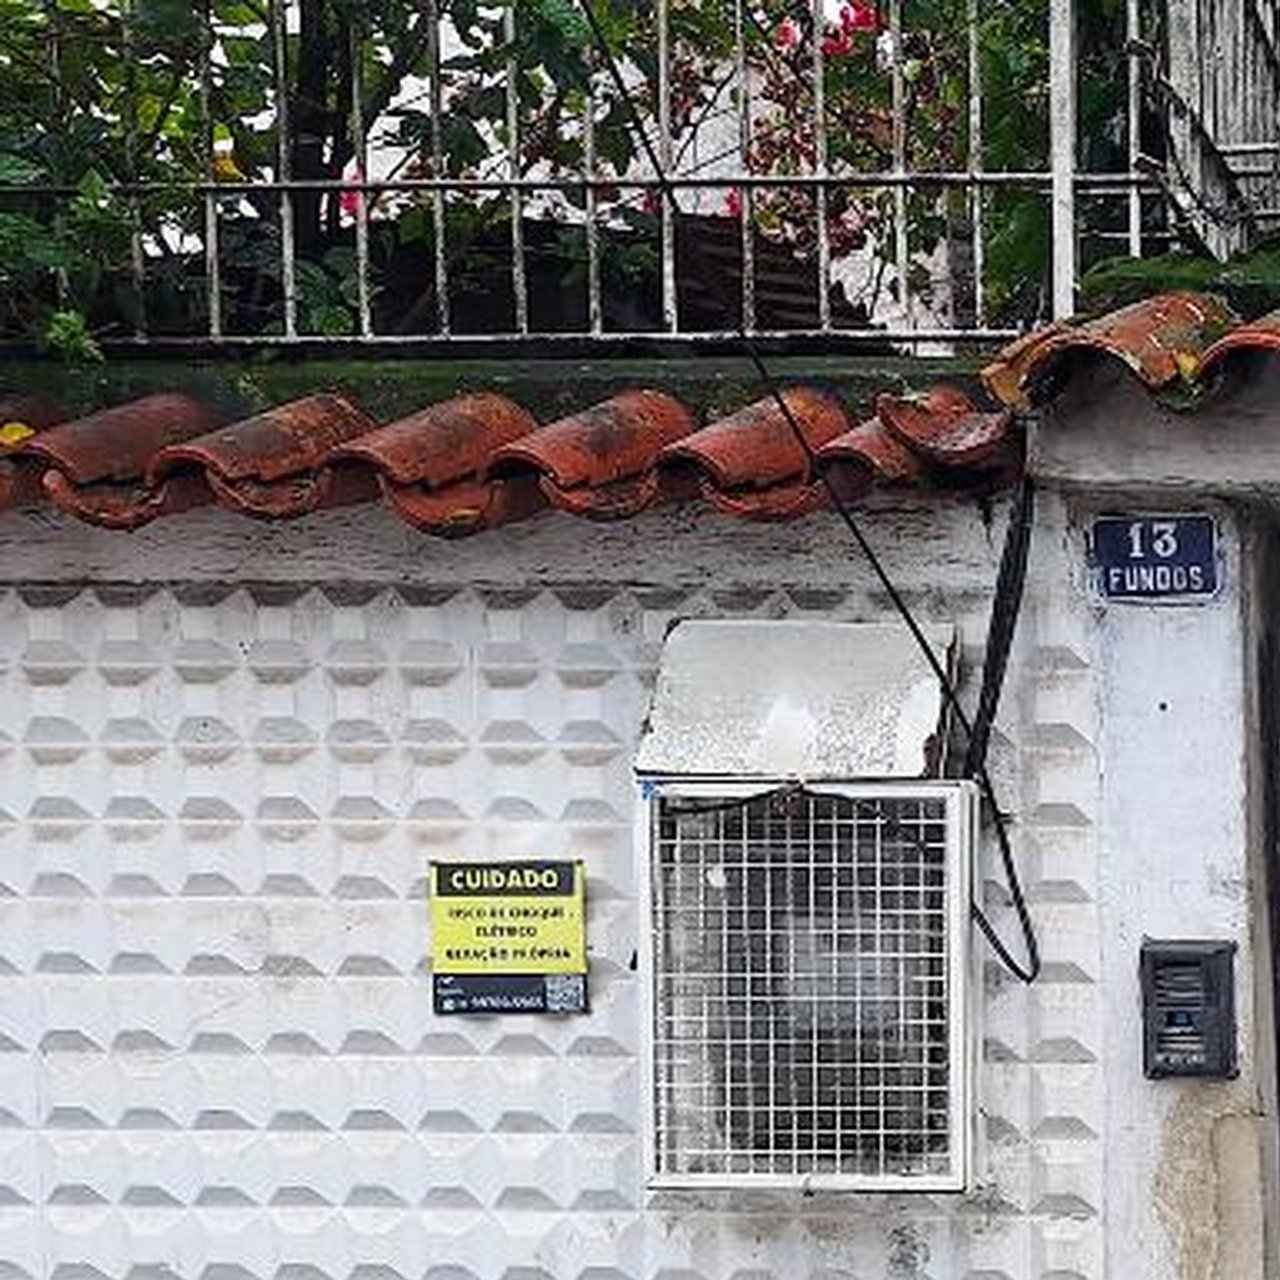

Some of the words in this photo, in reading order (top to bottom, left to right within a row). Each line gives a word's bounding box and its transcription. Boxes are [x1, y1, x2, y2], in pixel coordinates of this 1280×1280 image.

[1128, 522, 1178, 558] 13
[1109, 565, 1204, 591] FUNDOS
[451, 868, 559, 889] CUIDADO
